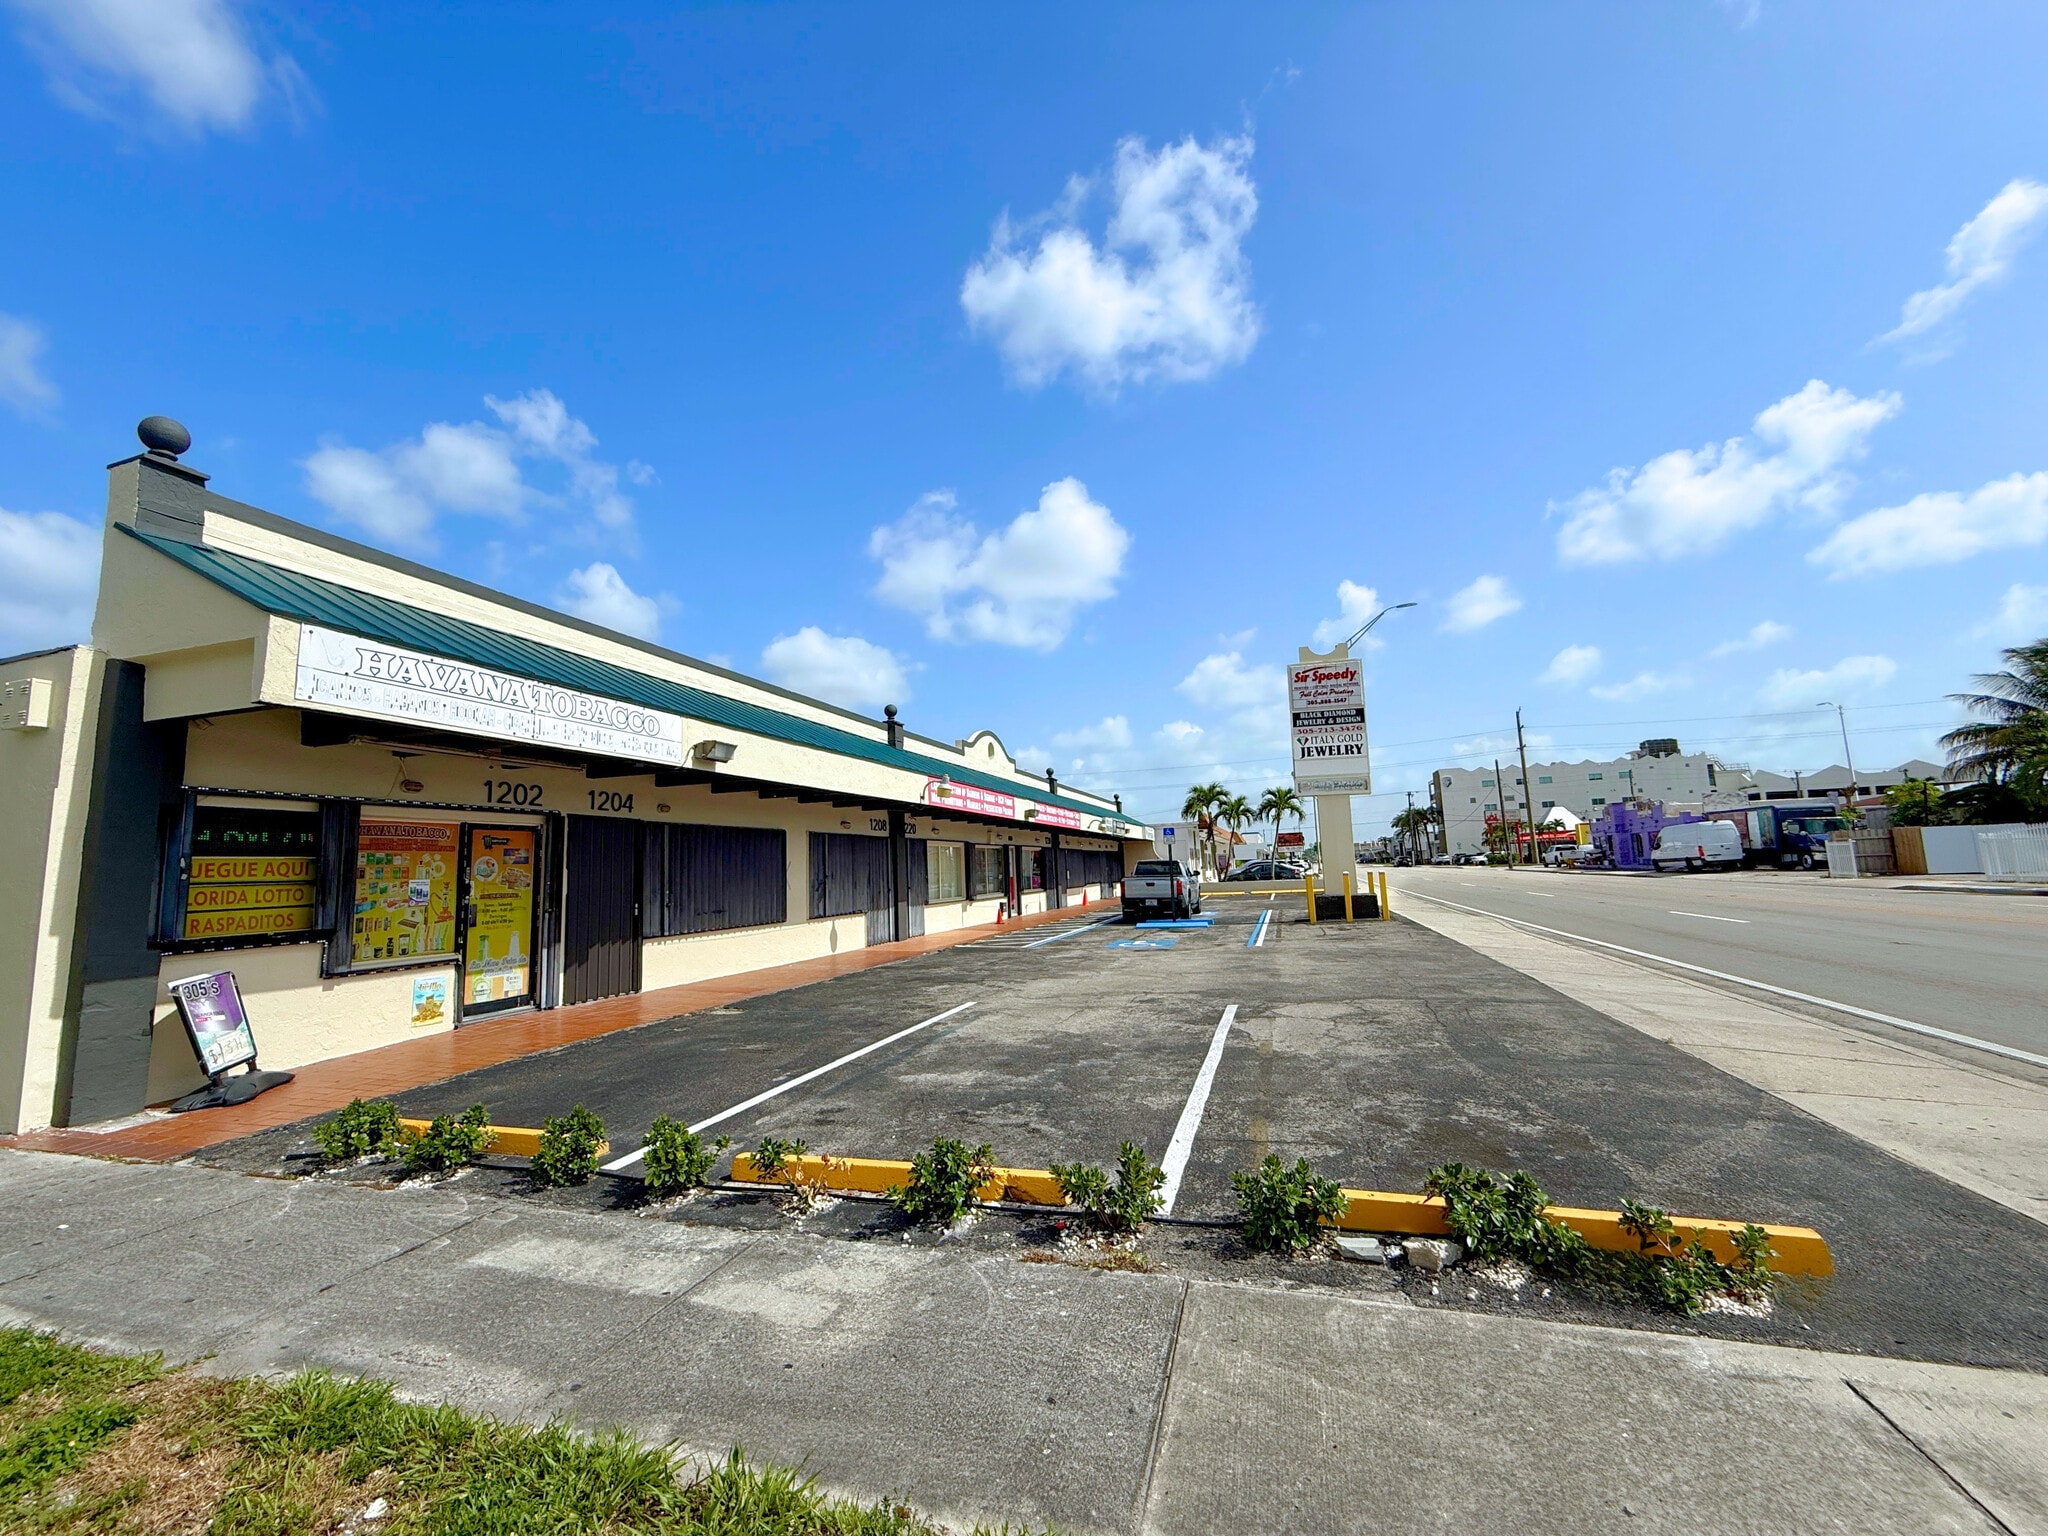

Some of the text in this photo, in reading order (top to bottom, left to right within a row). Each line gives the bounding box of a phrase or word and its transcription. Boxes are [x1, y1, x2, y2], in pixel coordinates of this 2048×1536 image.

[1294, 667, 1356, 684] Sir Speedy
[353, 647, 529, 710] HAVANA
[531, 684, 661, 737] TOBACCO
[1299, 690, 1312, 698] Full
[1329, 688, 1354, 697] Printing
[1296, 718, 1326, 727] JEWELRY
[1336, 715, 1361, 723] DESIGN
[1300, 709, 1356, 719] BLACK DIAMOND
[1297, 725, 1363, 735] 305-713-3476
[1310, 733, 1363, 744] ITALY GOLD
[1300, 743, 1363, 759] JEWELRY
[483, 779, 543, 807] 1202
[588, 789, 634, 813] 1204
[869, 818, 888, 832] 1208
[904, 823, 917, 835] 220
[262, 861, 309, 878] AQUI
[255, 887, 304, 904] LOTTO
[190, 913, 294, 934] RASPADITOS
